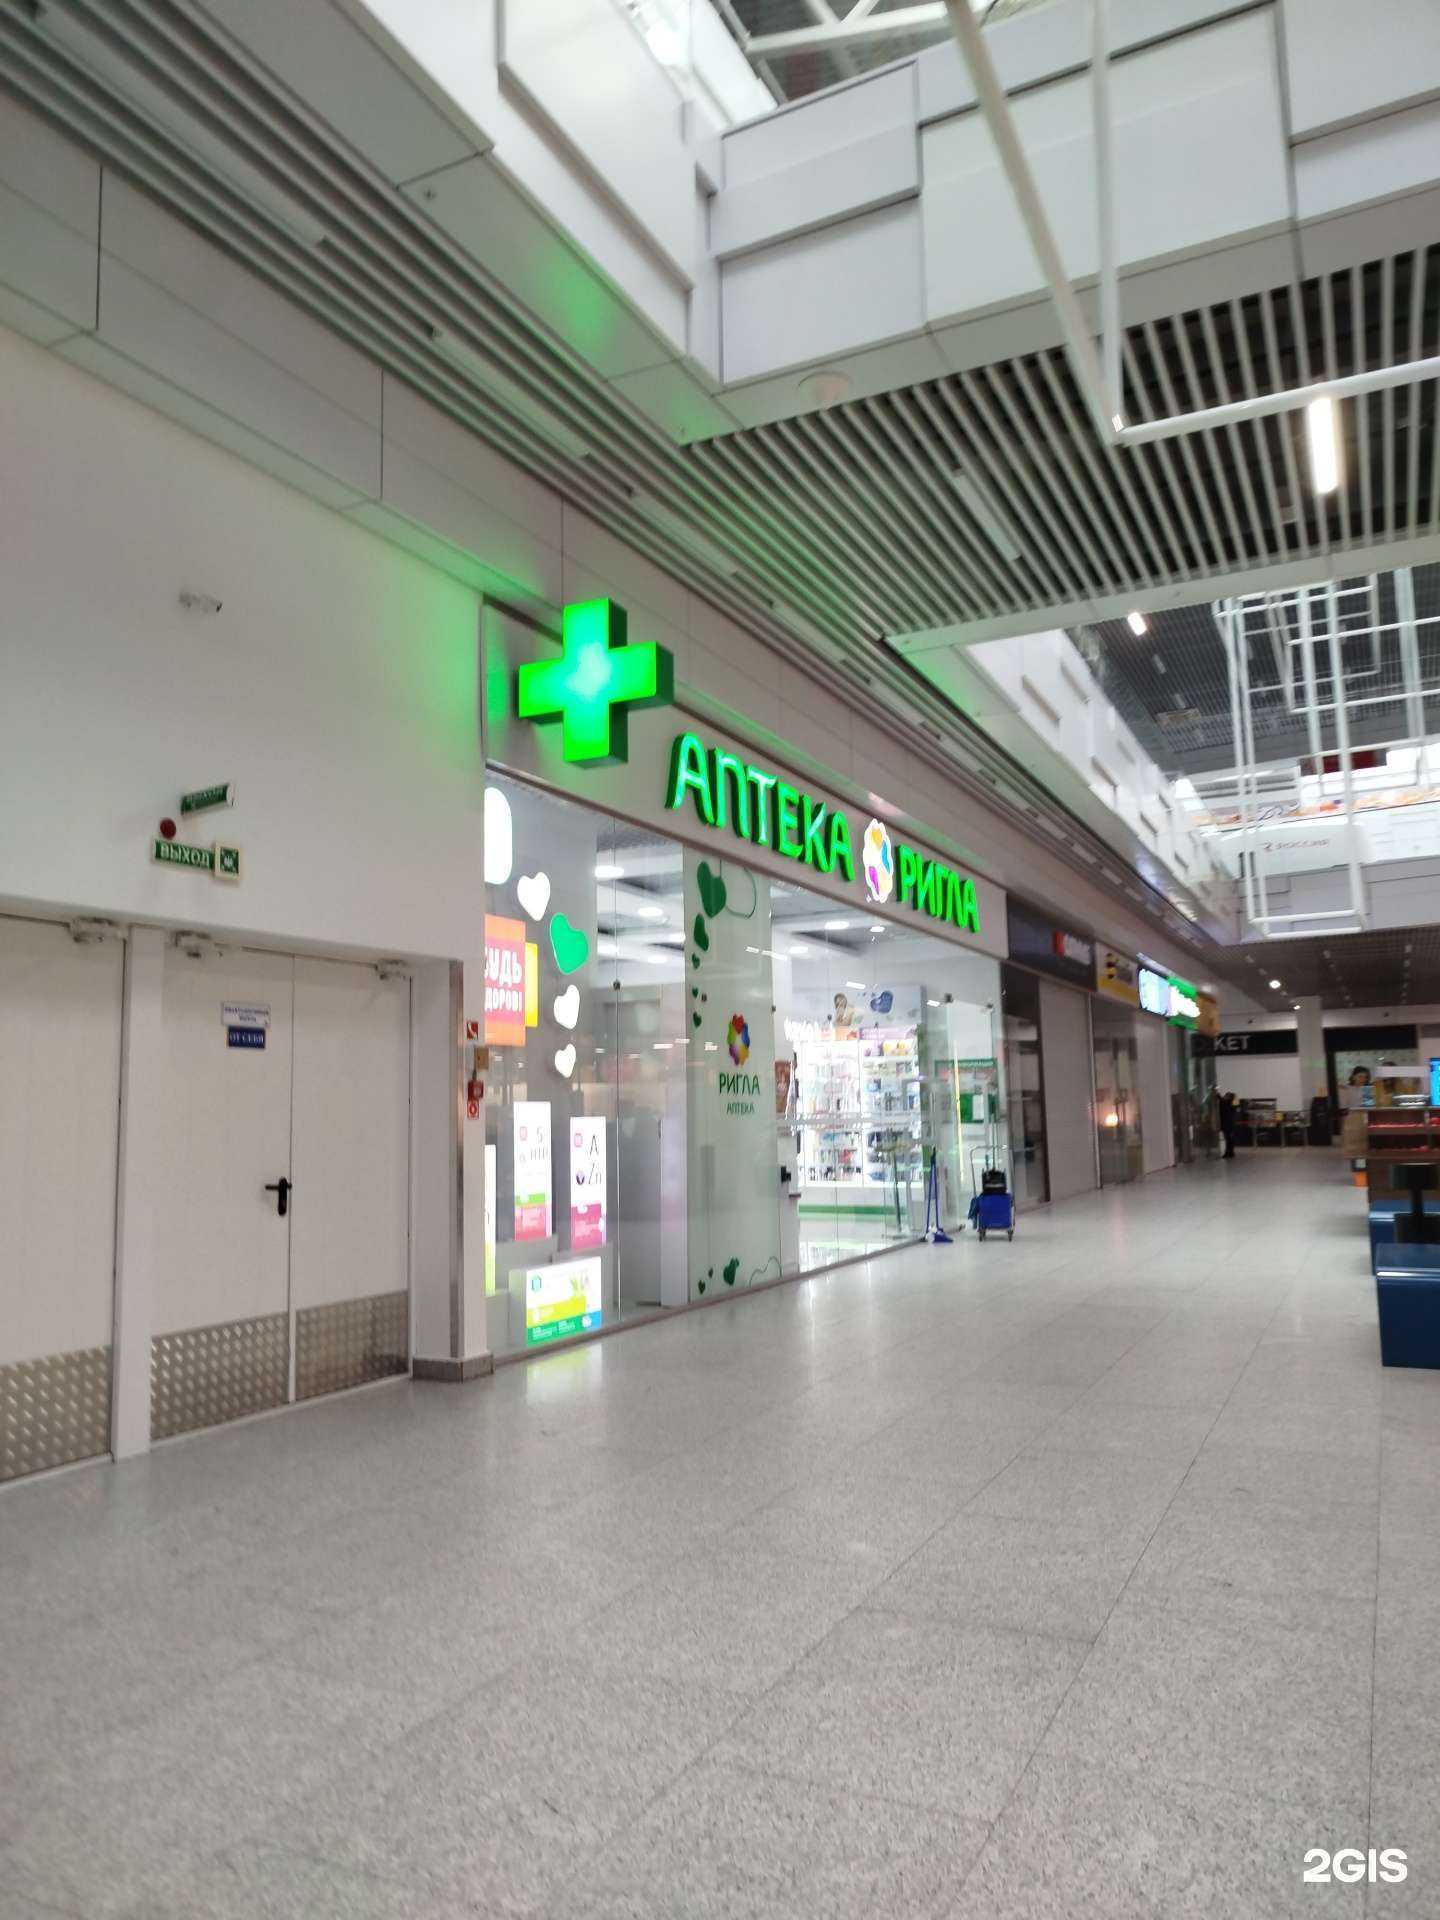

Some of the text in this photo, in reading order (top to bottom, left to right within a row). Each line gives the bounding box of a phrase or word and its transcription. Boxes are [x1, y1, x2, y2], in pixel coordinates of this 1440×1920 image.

[665, 731, 980, 933] АПТЕКА РИГЛА
[159, 842, 211, 867] ВЫХОД
[1214, 1034, 1251, 1051] KET
[719, 1072, 761, 1095] РИГЛА
[726, 1102, 755, 1115] АПТЕКА
